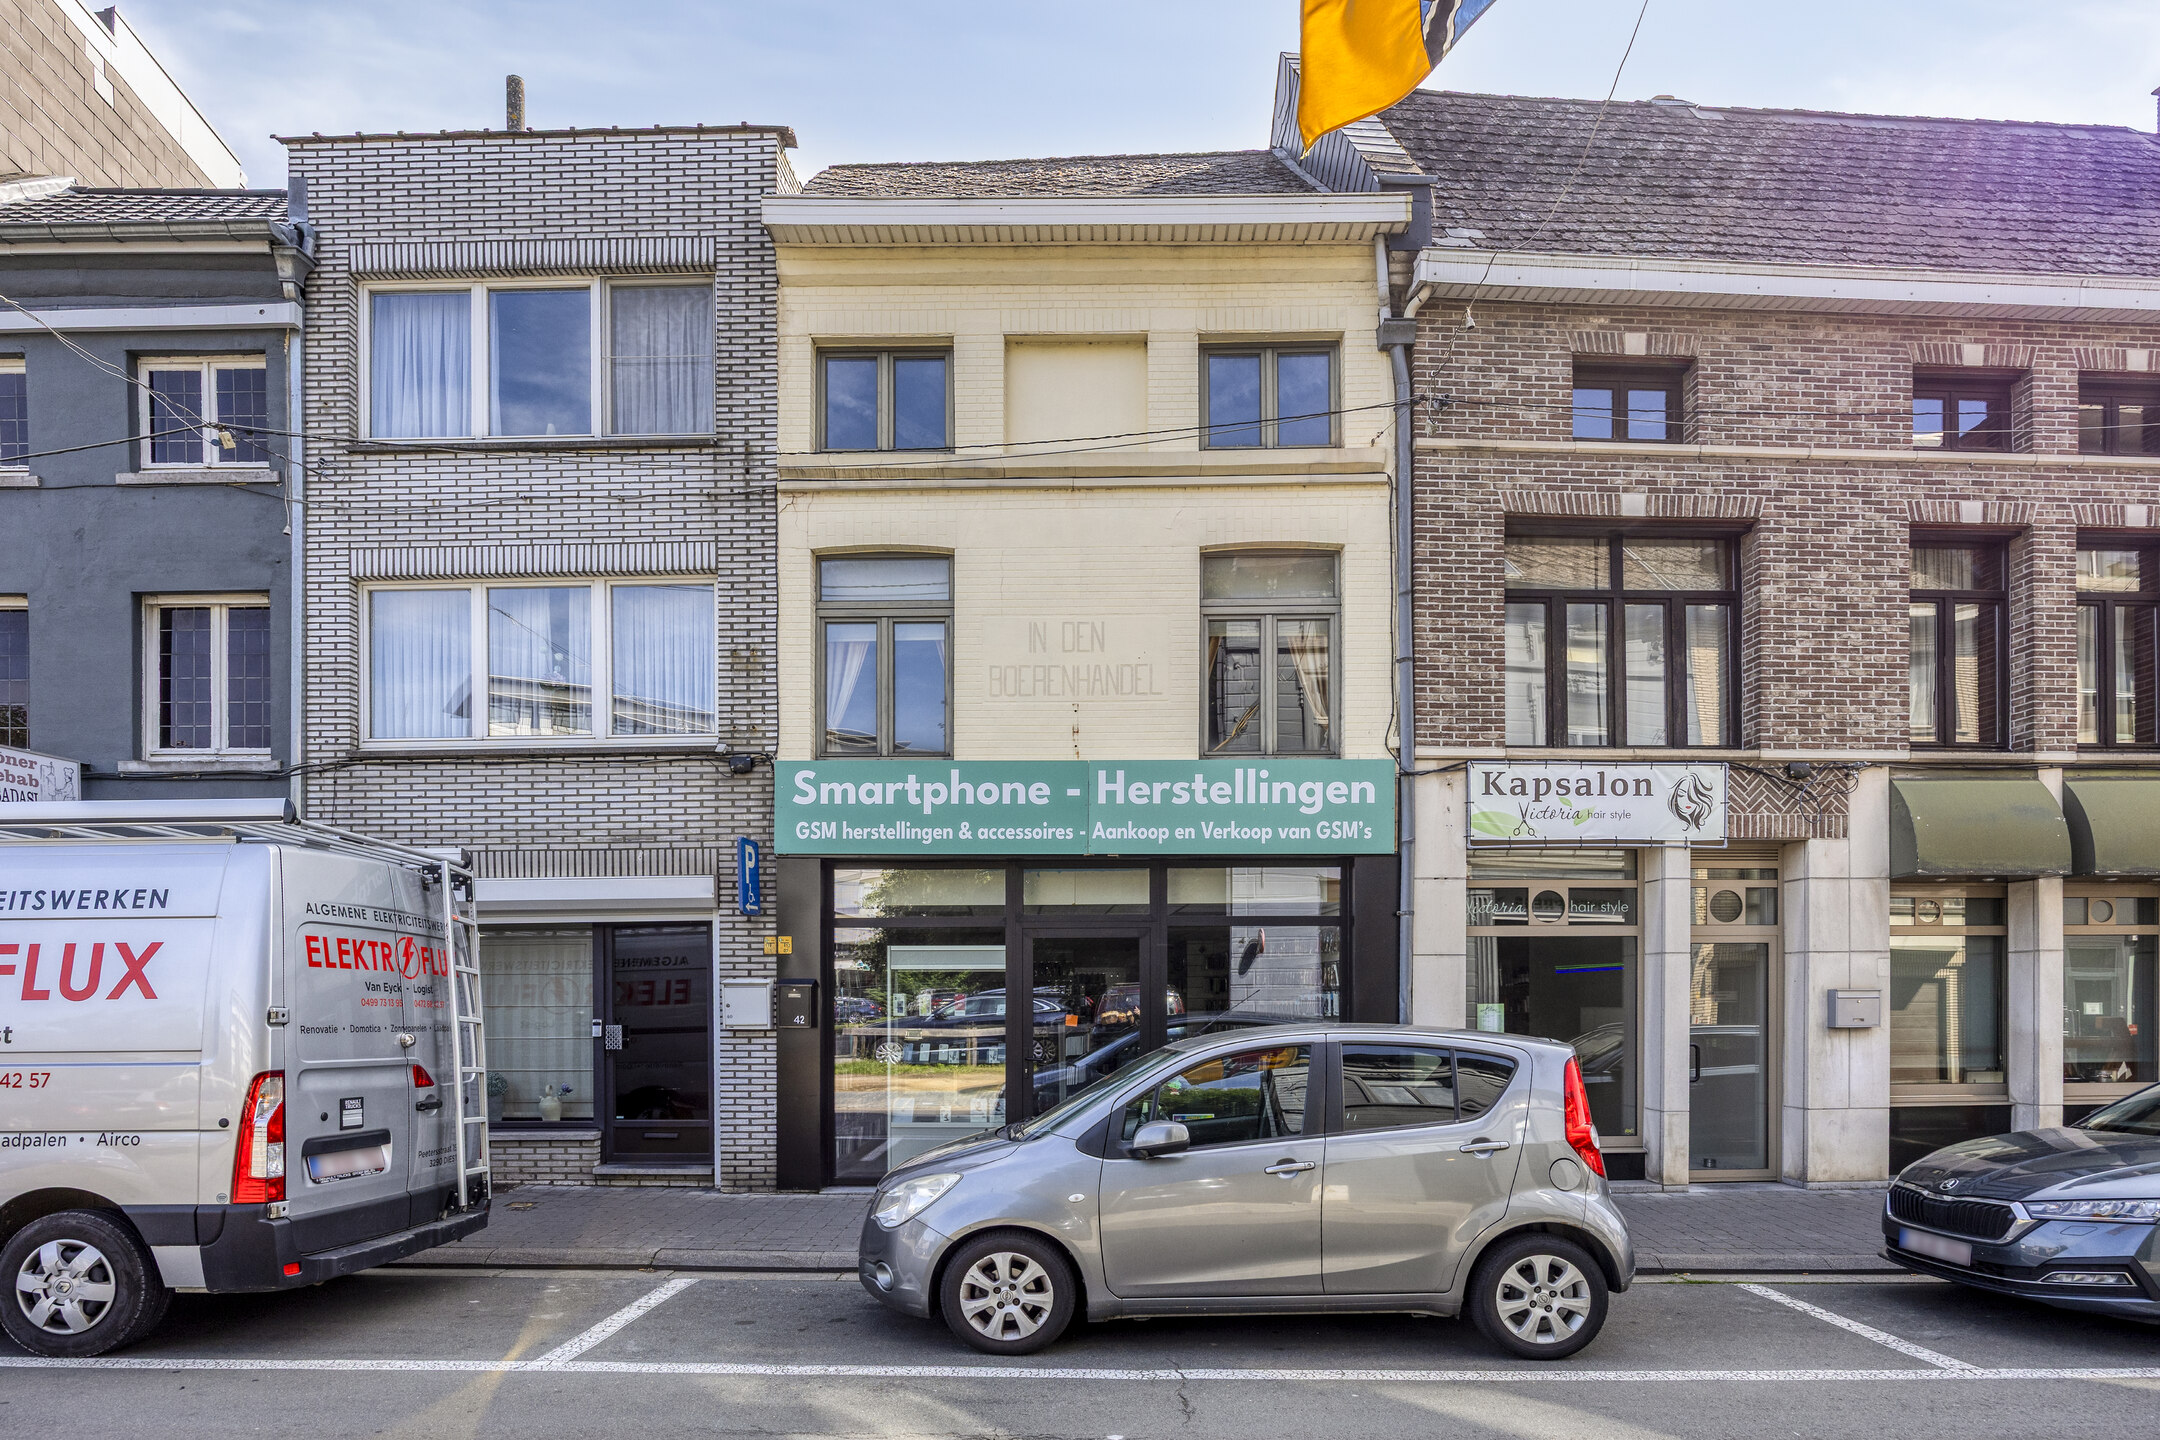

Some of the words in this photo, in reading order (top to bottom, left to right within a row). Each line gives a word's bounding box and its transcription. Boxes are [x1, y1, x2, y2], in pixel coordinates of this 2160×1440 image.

[1028, 621, 1047, 653] IN
[1061, 621, 1105, 653] DEN
[989, 663, 1163, 697] BOERENHANDEL
[792, 768, 1051, 815] Smartphone
[1097, 768, 1376, 815] Herstellingen
[1481, 771, 1654, 803] Kapsalon
[1516, 801, 1583, 828] Victoria
[1587, 809, 1607, 819] hair
[1610, 809, 1632, 821] style
[795, 821, 837, 840] GSM
[842, 820, 953, 845] herstellingen
[958, 821, 973, 840] &
[977, 821, 1074, 840] accessoires
[1092, 820, 1170, 845] Aankoop
[1174, 827, 1196, 839] en
[1201, 820, 1273, 845] Verkoop
[1278, 827, 1311, 839] van
[1316, 820, 1372, 839] GSM's
[745, 844, 756, 884] P
[306, 902, 368, 920] ALGEMENE
[1570, 901, 1596, 913] hair
[1600, 900, 1629, 915] style
[365, 981, 381, 992] Van
[383, 982, 403, 994] Eyck
[413, 984, 434, 996] Logist
[300, 1024, 339, 1034] Renovatie
[350, 1024, 382, 1033] Domotica
[793, 1015, 805, 1024] 42
[29, 1072, 51, 1089] 57
[1, 1132, 67, 1150] adpalen
[96, 1131, 141, 1147] Airco
